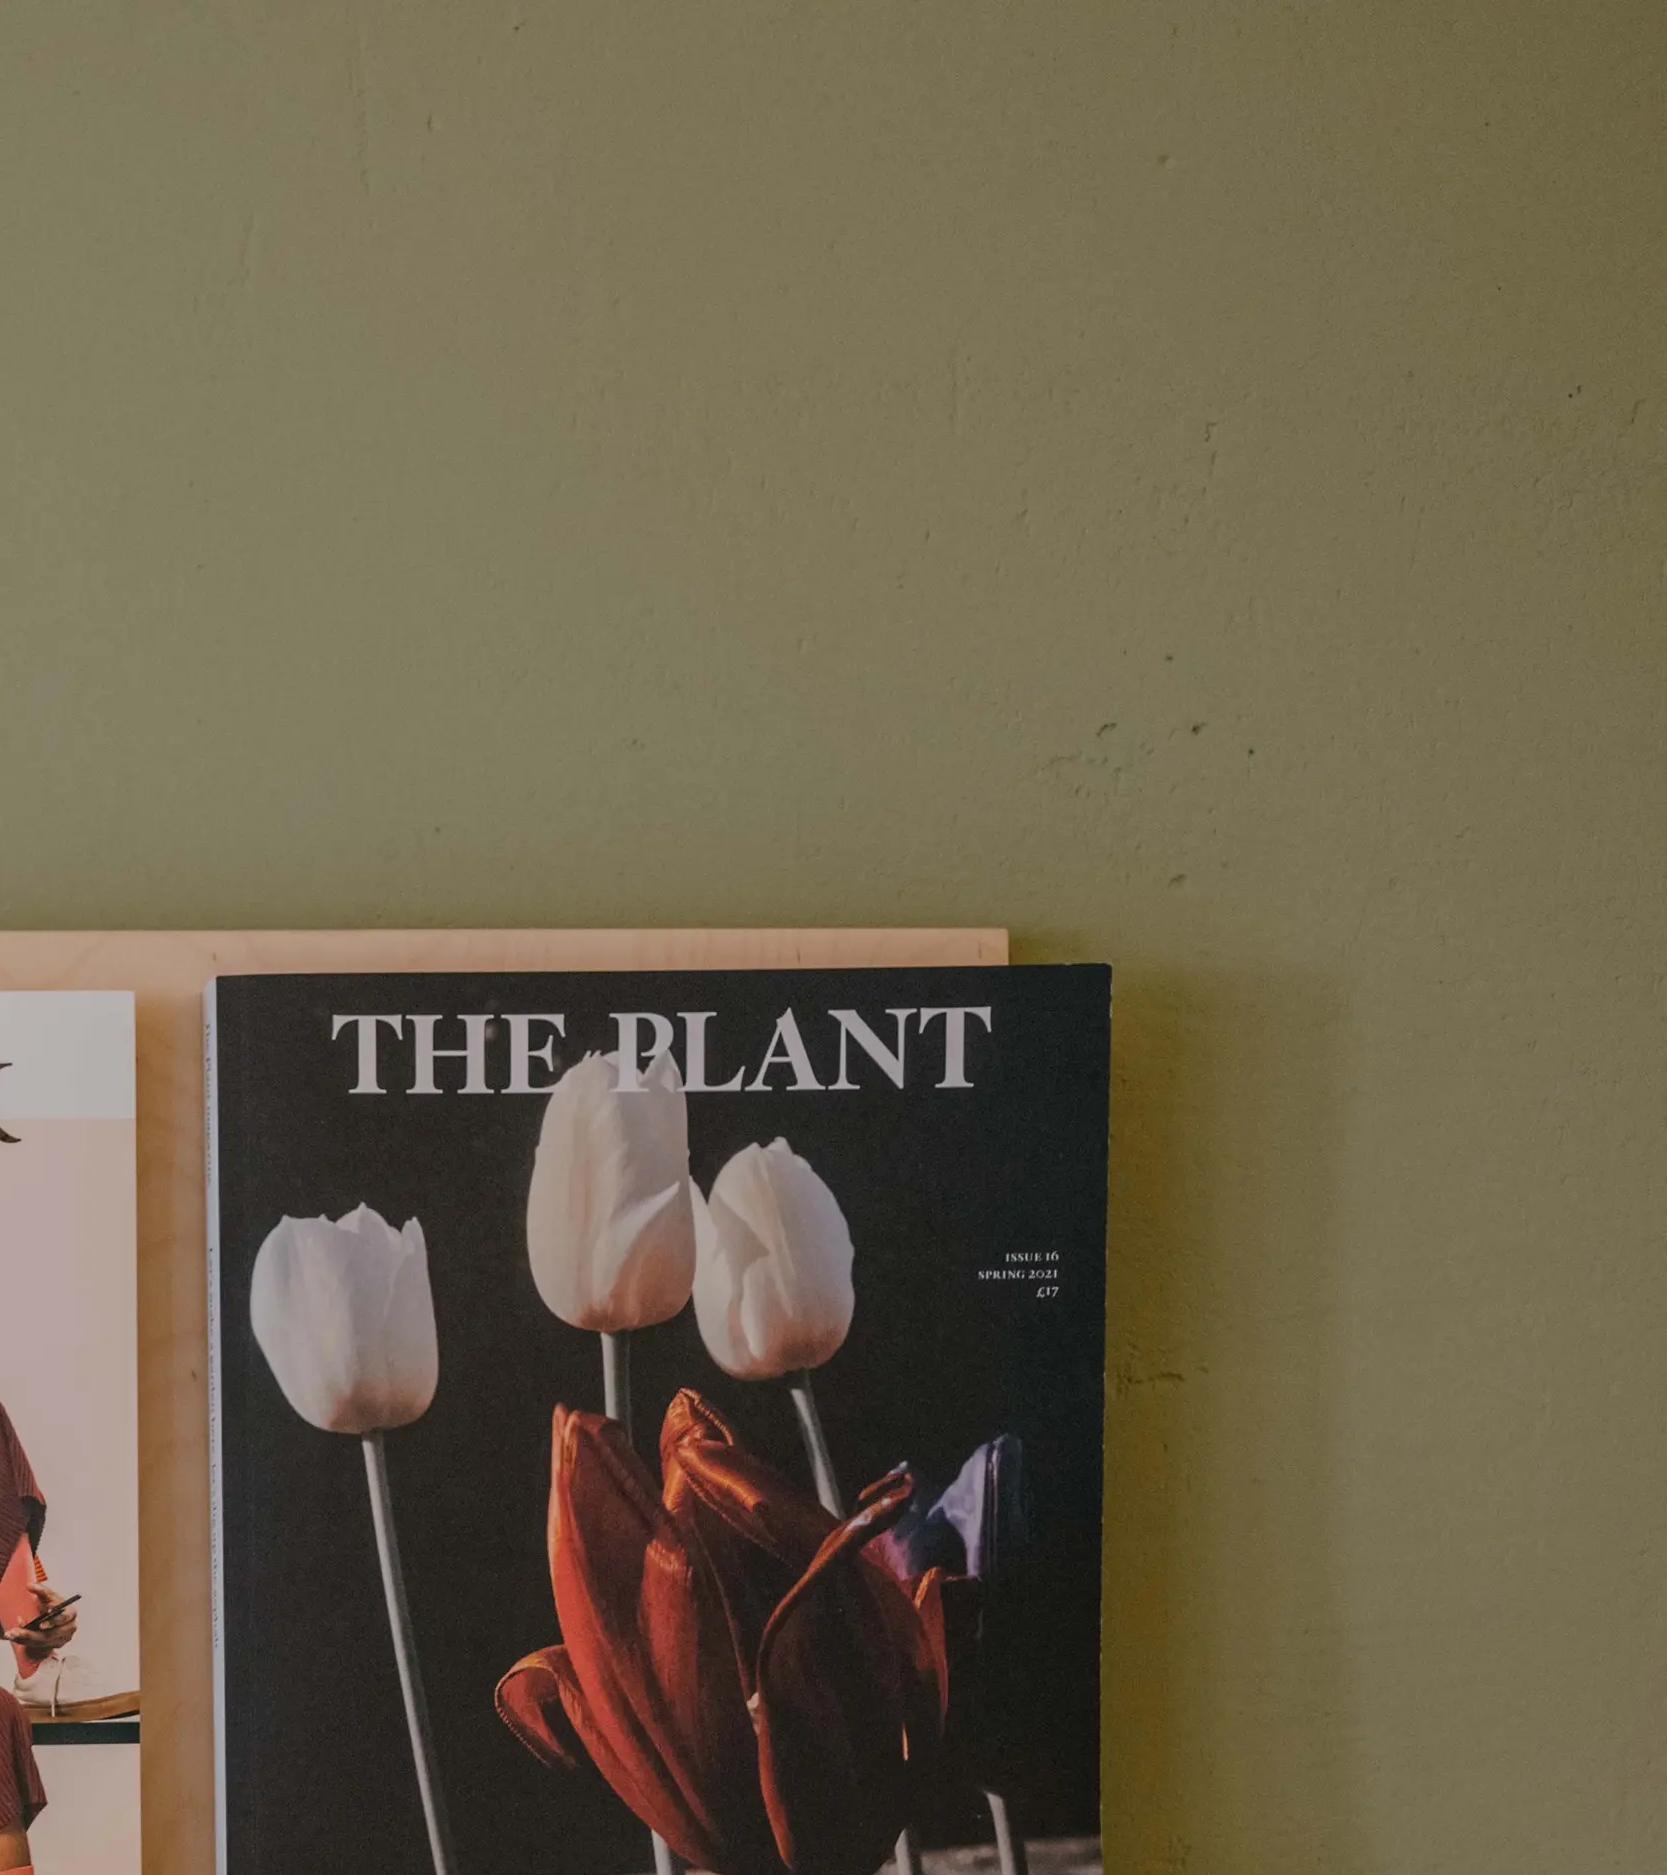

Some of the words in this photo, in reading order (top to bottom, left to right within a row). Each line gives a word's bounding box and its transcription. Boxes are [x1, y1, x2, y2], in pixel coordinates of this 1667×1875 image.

[331, 1012, 567, 1096] THE
[609, 1006, 993, 1094] PLANT
[1005, 1252, 1041, 1262] ISSUE
[1045, 1250, 1059, 1261] 16
[978, 1270, 1025, 1279] SPRING
[1028, 1269, 1057, 1278] 2021
[1036, 1286, 1059, 1298] £17
